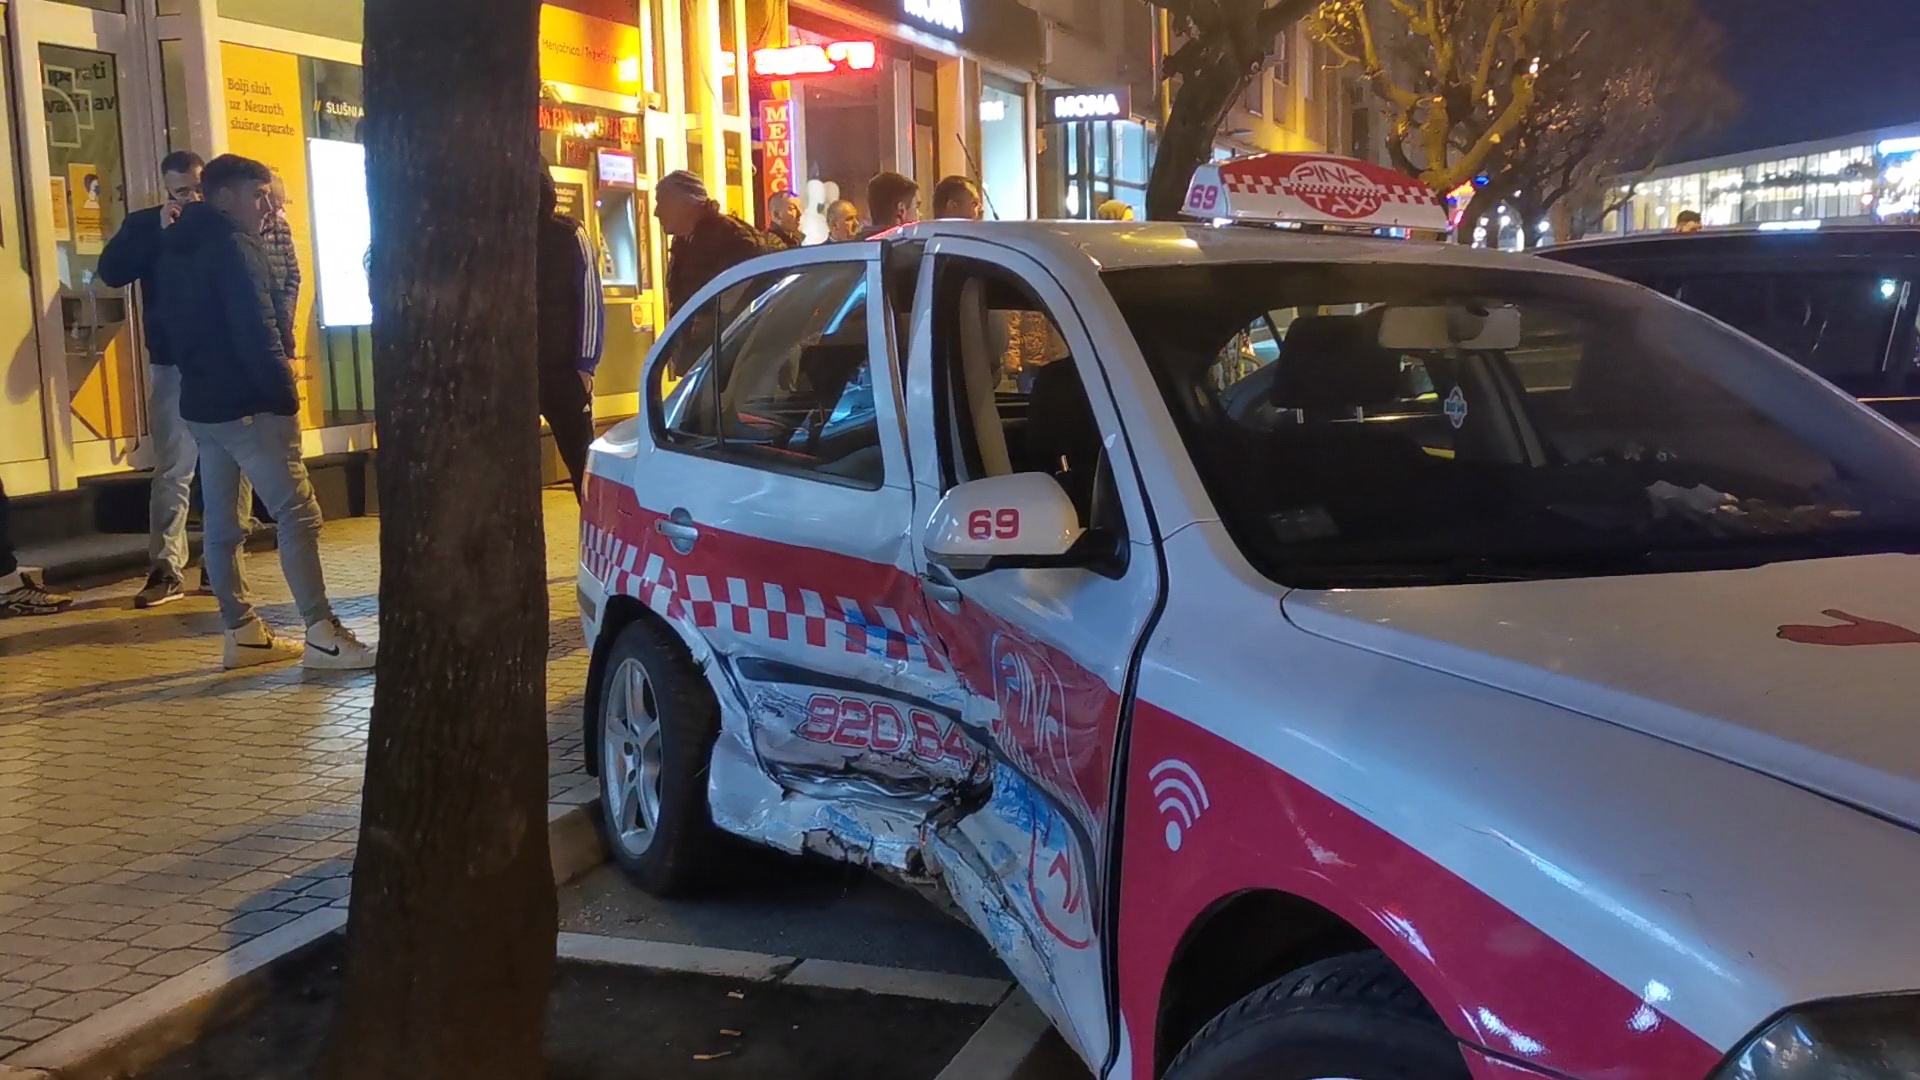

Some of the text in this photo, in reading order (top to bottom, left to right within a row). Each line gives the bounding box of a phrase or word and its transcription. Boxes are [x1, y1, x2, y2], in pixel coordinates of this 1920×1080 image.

[227, 78, 272, 96] Bolji sluh
[229, 100, 284, 117] uz Neuroth
[1055, 94, 1120, 118] MONA
[230, 117, 295, 136] slušne aparate
[1296, 163, 1366, 186] PINK
[1190, 184, 1218, 211] 69
[1304, 193, 1377, 217] TAXI
[967, 508, 1020, 540] 69
[797, 694, 906, 754] 920
